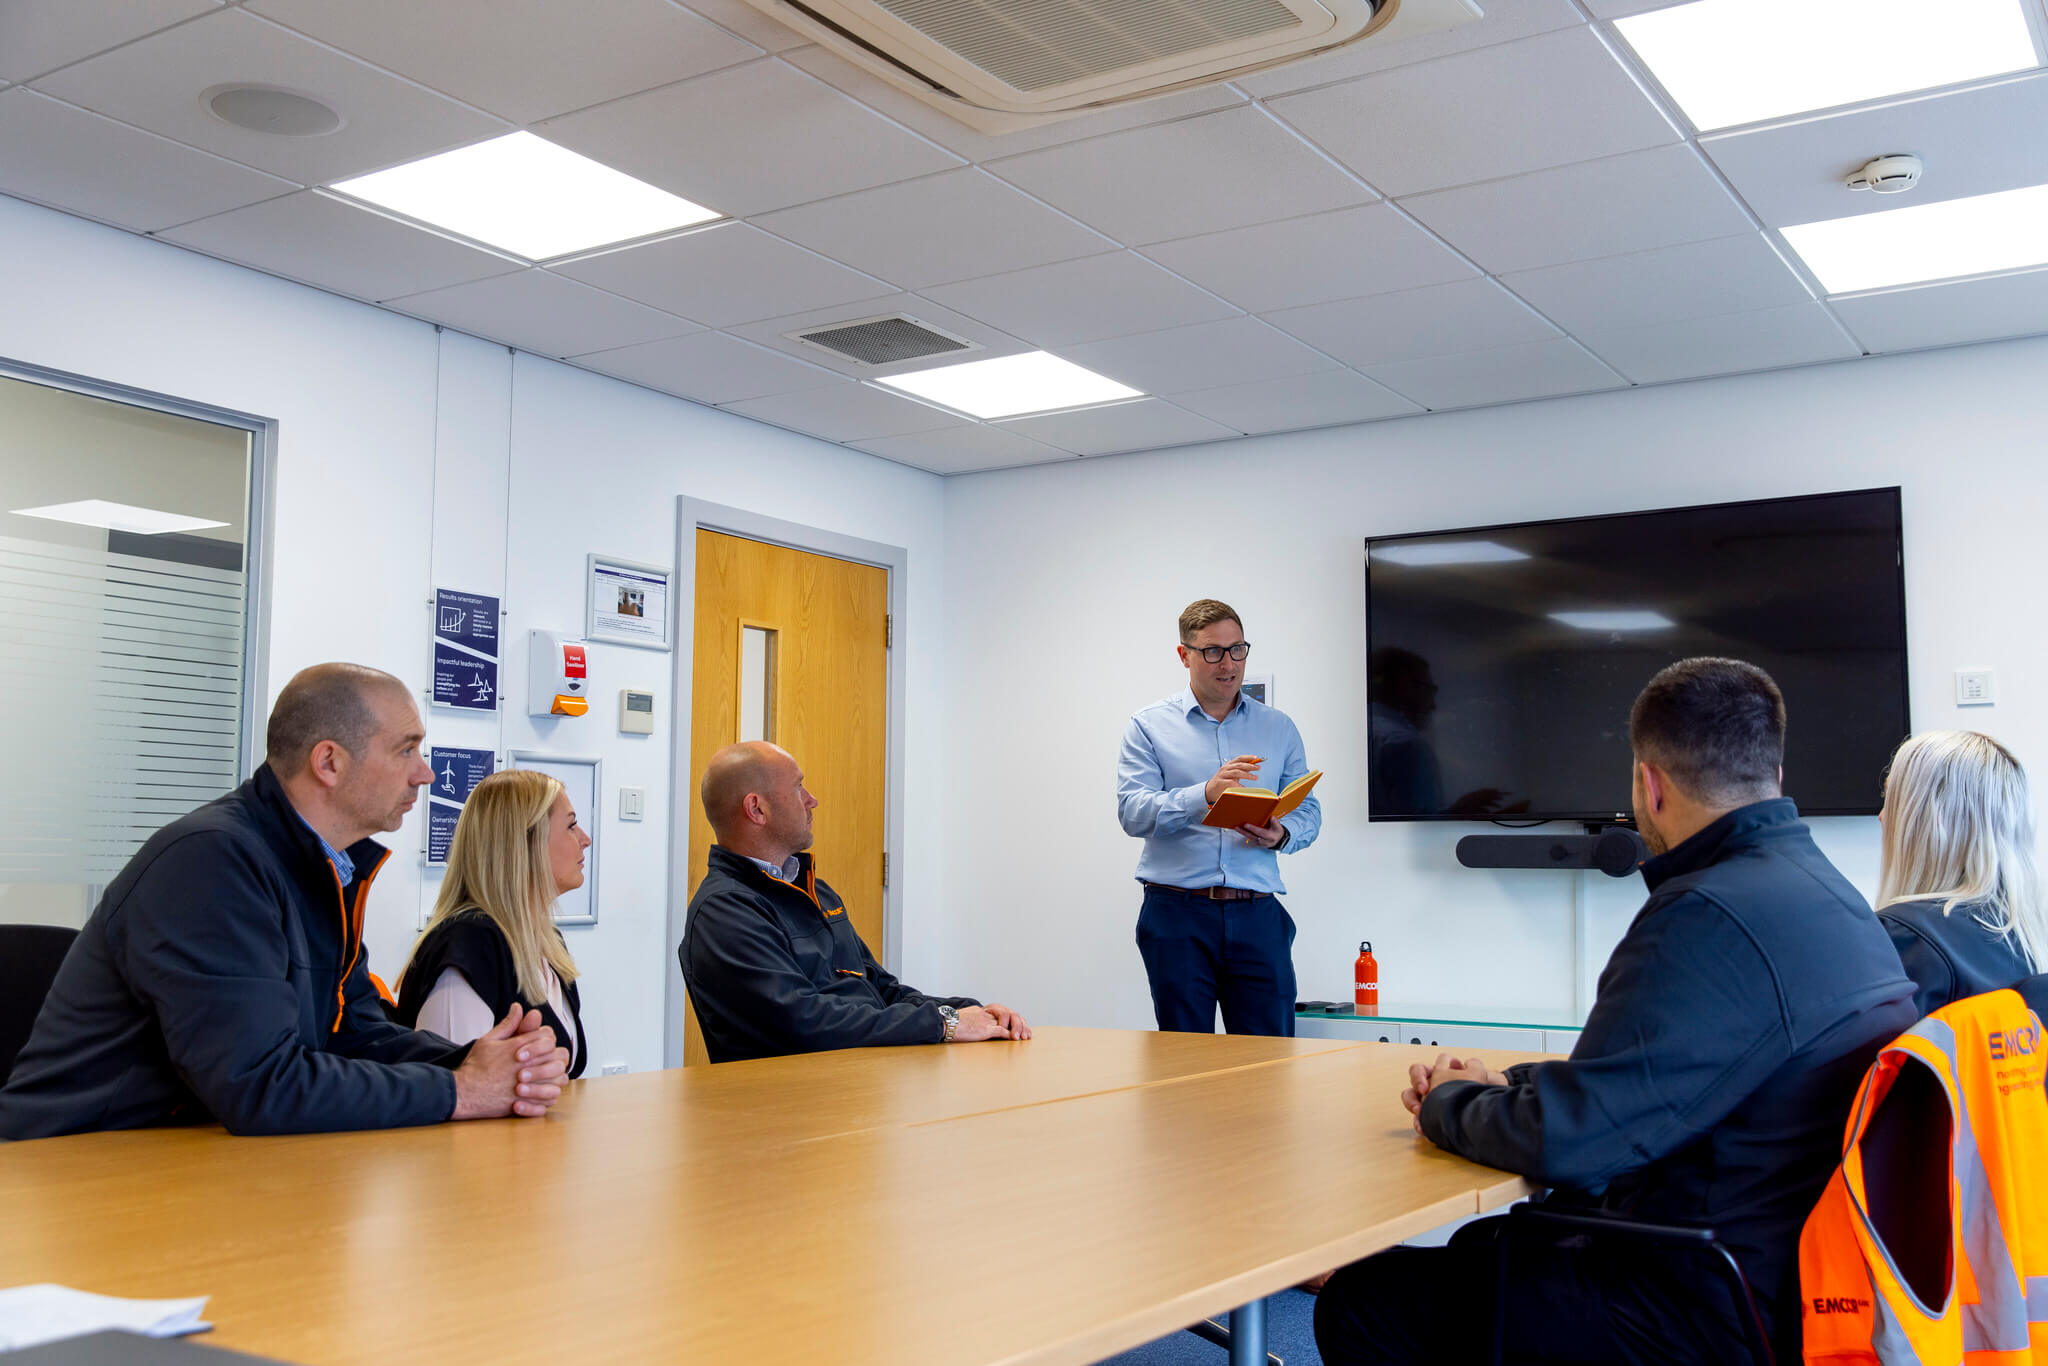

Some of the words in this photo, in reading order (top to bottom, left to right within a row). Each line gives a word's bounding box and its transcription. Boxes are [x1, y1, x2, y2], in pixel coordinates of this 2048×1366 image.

[439, 592, 457, 602] Results
[457, 595, 483, 605] orientation
[437, 657, 460, 667] Impactful
[460, 659, 485, 669] leadership
[434, 750, 457, 759] Customer
[457, 751, 472, 759] focus
[431, 816, 458, 825] Ownership
[1354, 981, 1378, 990] EMCO
